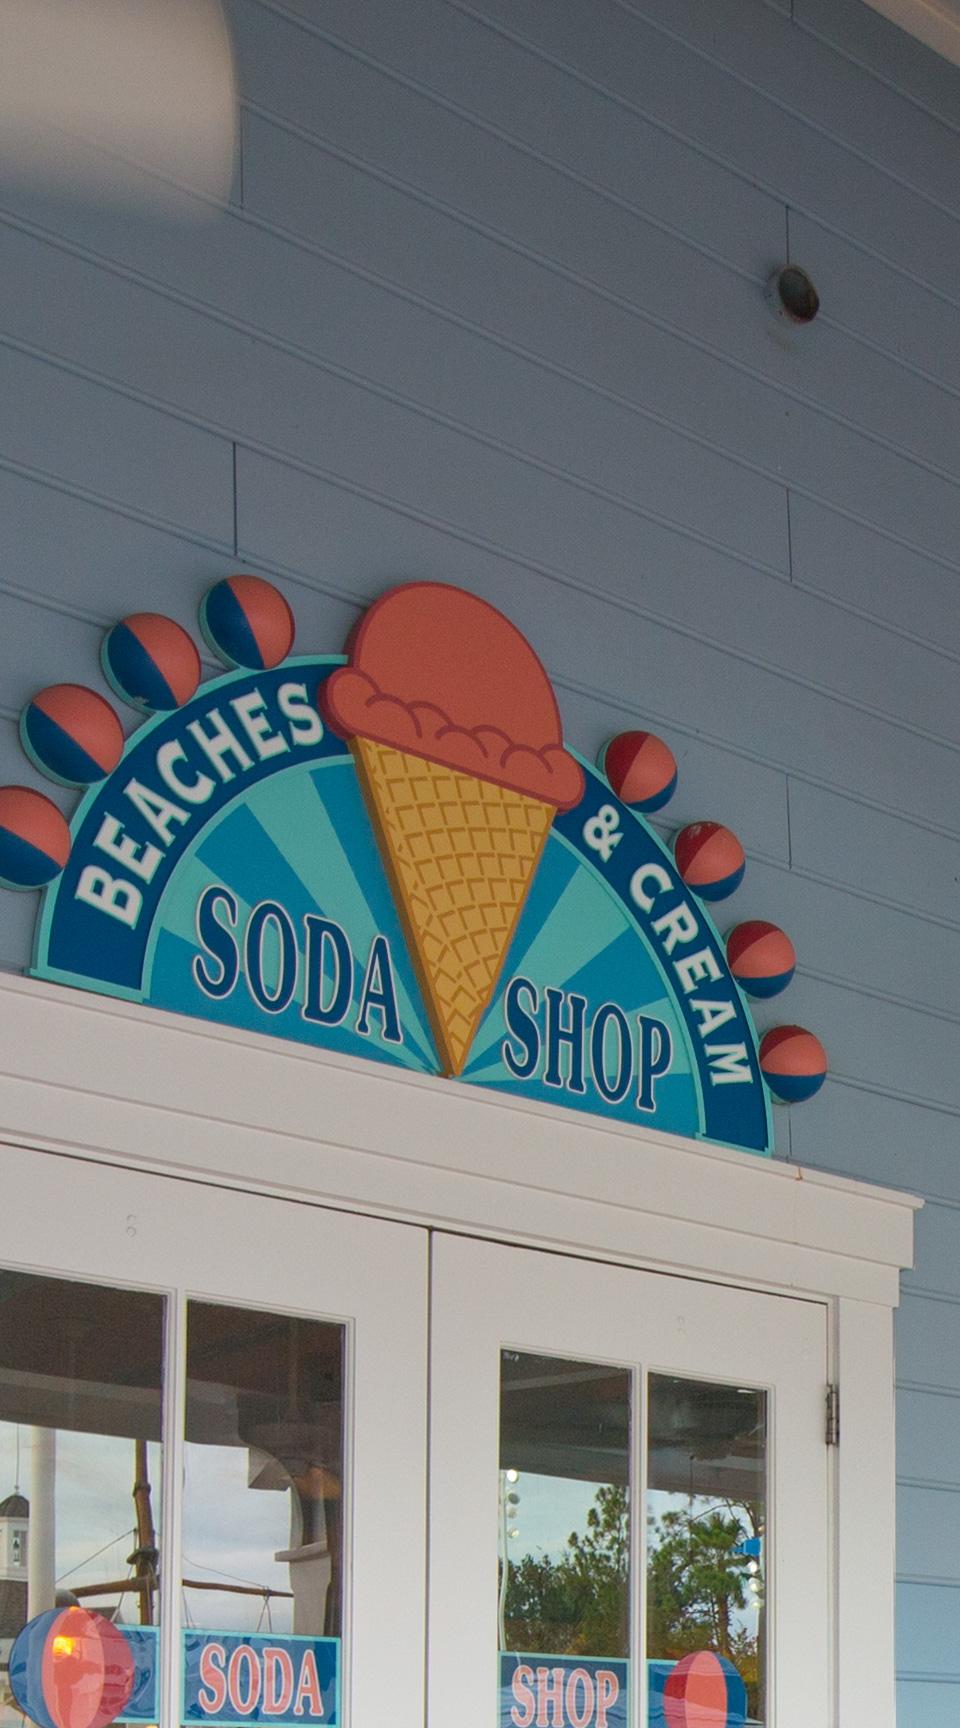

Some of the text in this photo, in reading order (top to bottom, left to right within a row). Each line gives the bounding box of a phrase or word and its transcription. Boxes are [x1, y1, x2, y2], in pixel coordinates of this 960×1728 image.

[75, 681, 753, 1087] BEACHES & CREAM
[192, 885, 673, 1113] SODA SHOP
[198, 1642, 324, 1718] SODA
